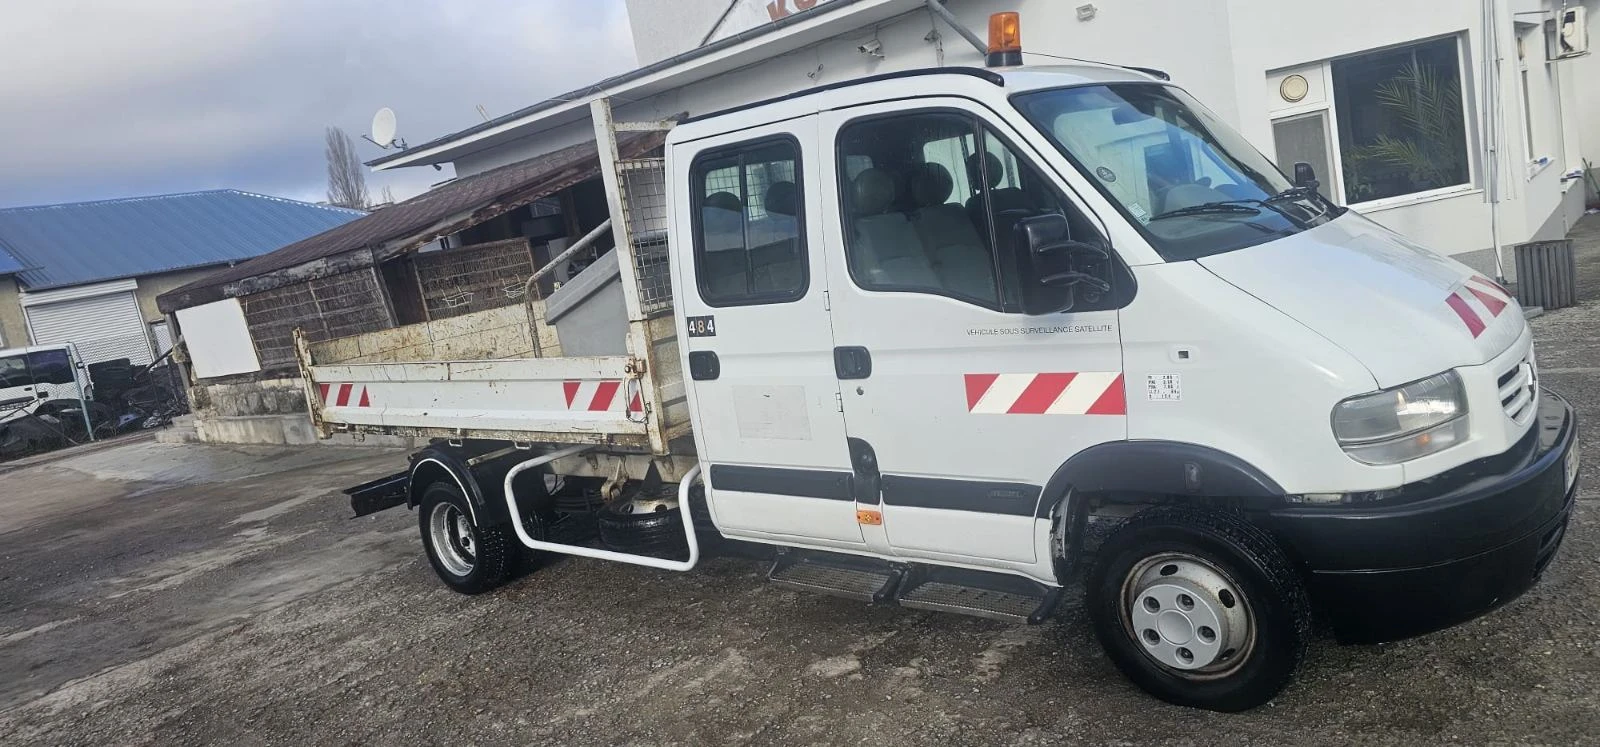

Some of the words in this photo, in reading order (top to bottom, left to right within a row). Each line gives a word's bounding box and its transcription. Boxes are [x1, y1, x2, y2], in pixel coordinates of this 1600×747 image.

[689, 320, 714, 334] 484
[966, 328, 998, 336] VEHICULE
[1000, 327, 1019, 335] SOUS
[1020, 325, 1073, 335] SURVEILLANCE
[1074, 324, 1112, 333] SATELLITE
